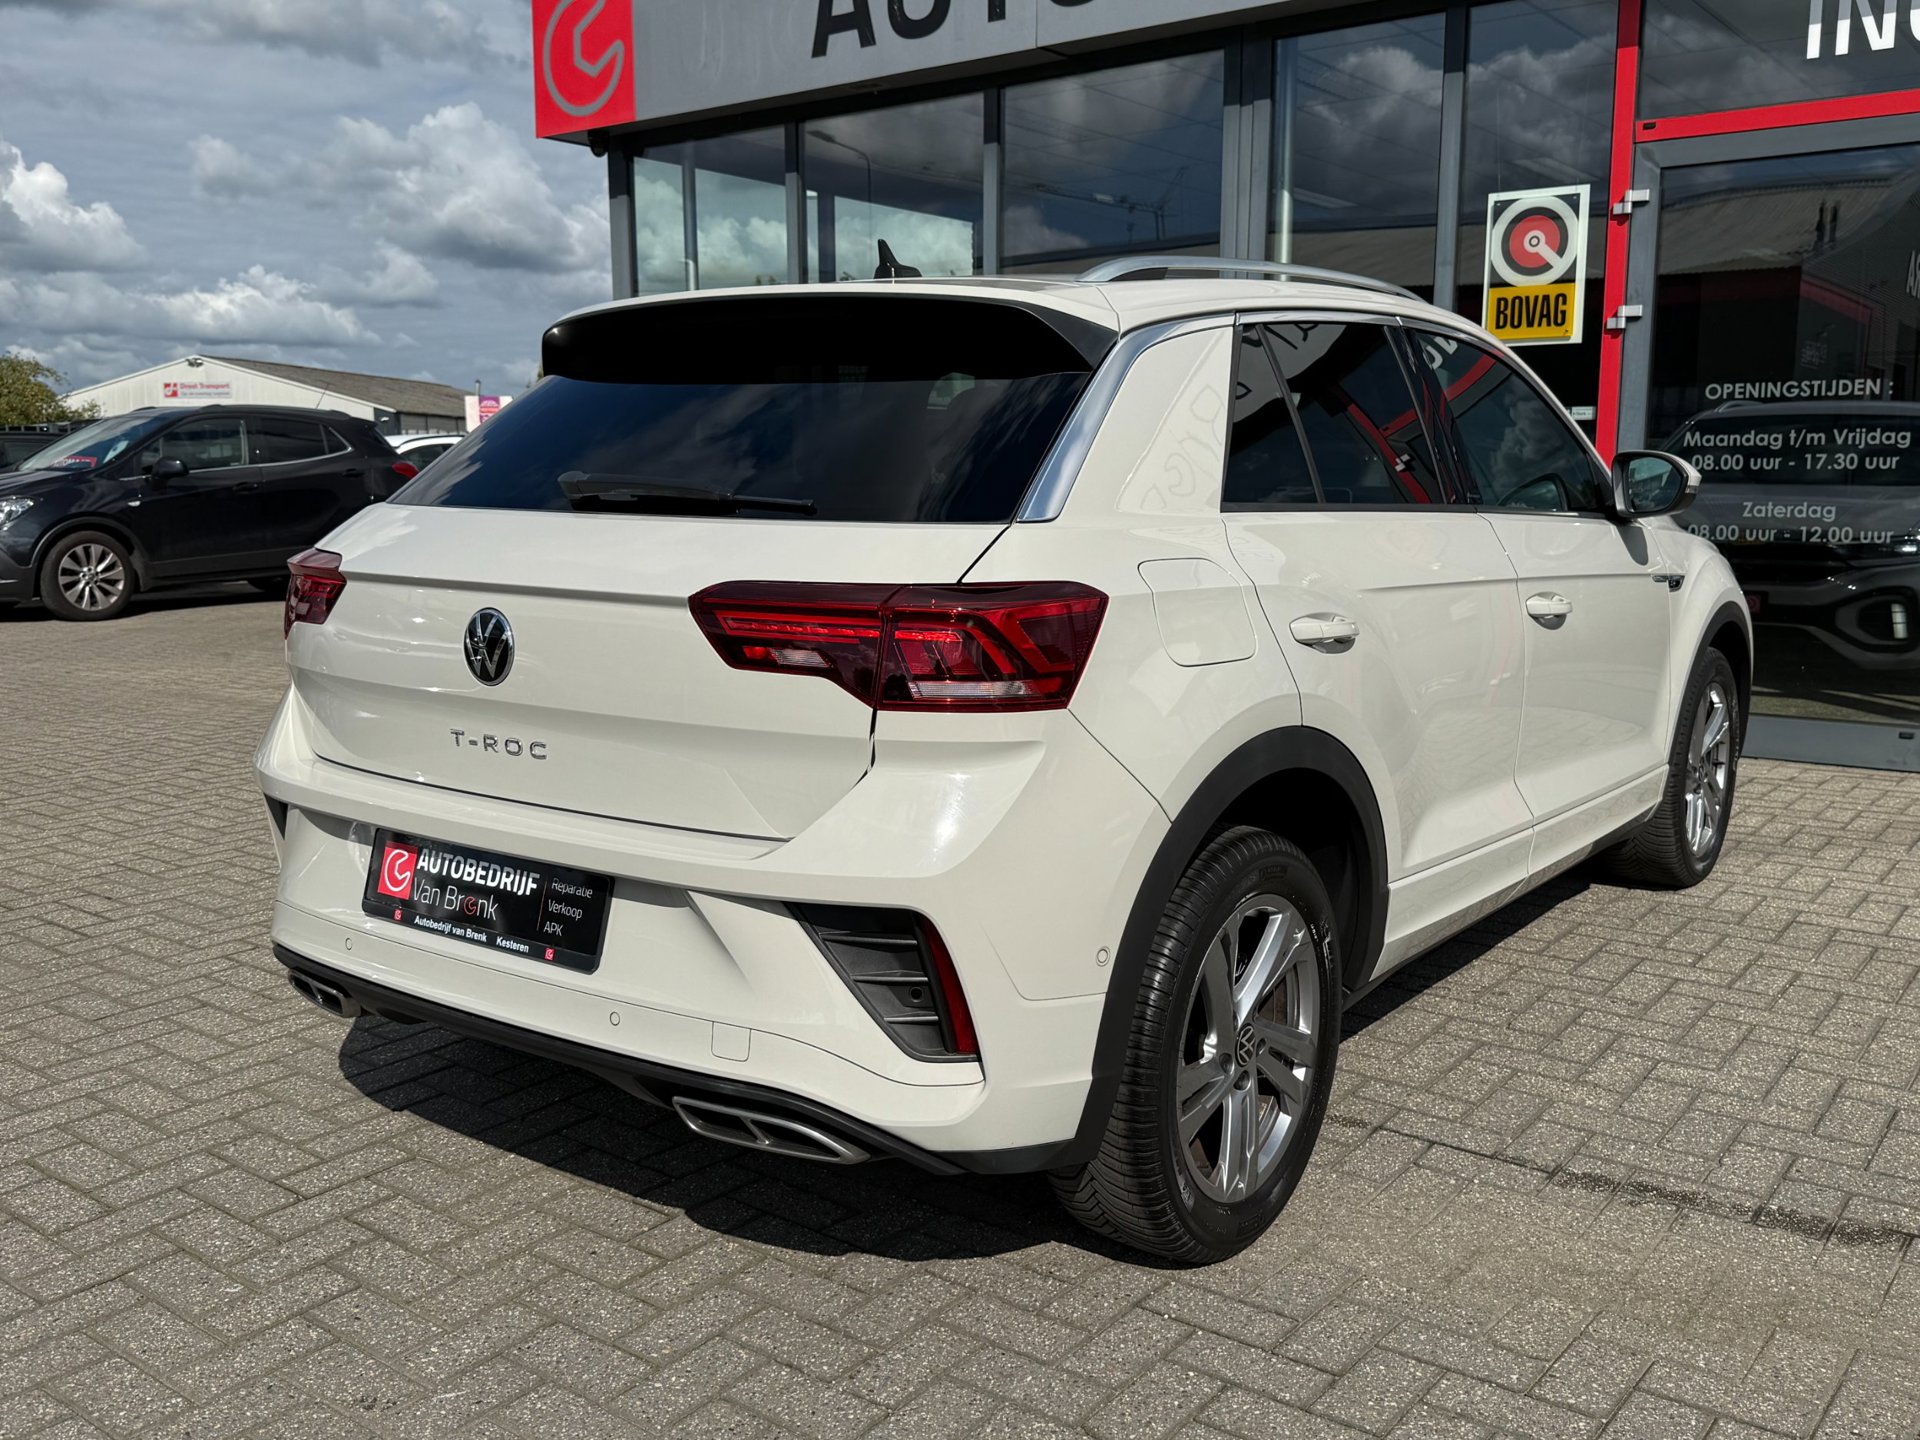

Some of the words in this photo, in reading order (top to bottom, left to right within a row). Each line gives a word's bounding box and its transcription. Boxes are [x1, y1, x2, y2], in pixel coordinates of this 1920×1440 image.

[1495, 292, 1568, 330] BOVAG
[1704, 378, 1881, 400] OPENINGSTIJDEN
[1683, 430, 1783, 449] Maandag
[1789, 428, 1826, 448] t/m
[1833, 427, 1911, 449] Vrijdag
[1691, 454, 1744, 471] 08.00
[1750, 457, 1782, 470] uur
[1804, 453, 1858, 470] 17.30
[1865, 456, 1900, 470] uur
[1742, 501, 1837, 522] Zaterdag
[1687, 524, 1739, 541] 08.00
[1745, 528, 1777, 541] uur
[1799, 526, 1853, 543] 12.00
[1860, 530, 1894, 544] uur
[449, 728, 547, 760] T-ROC
[416, 848, 541, 896] AUTOBEDRIJF
[413, 877, 441, 906] Van
[551, 878, 593, 898] Reparatie
[548, 899, 583, 921] Verkoop
[414, 915, 452, 934] Autobedrijf
[452, 926, 465, 937] van
[465, 928, 488, 943] Brenk
[496, 936, 530, 953] Kesteren
[543, 921, 563, 937] APK
